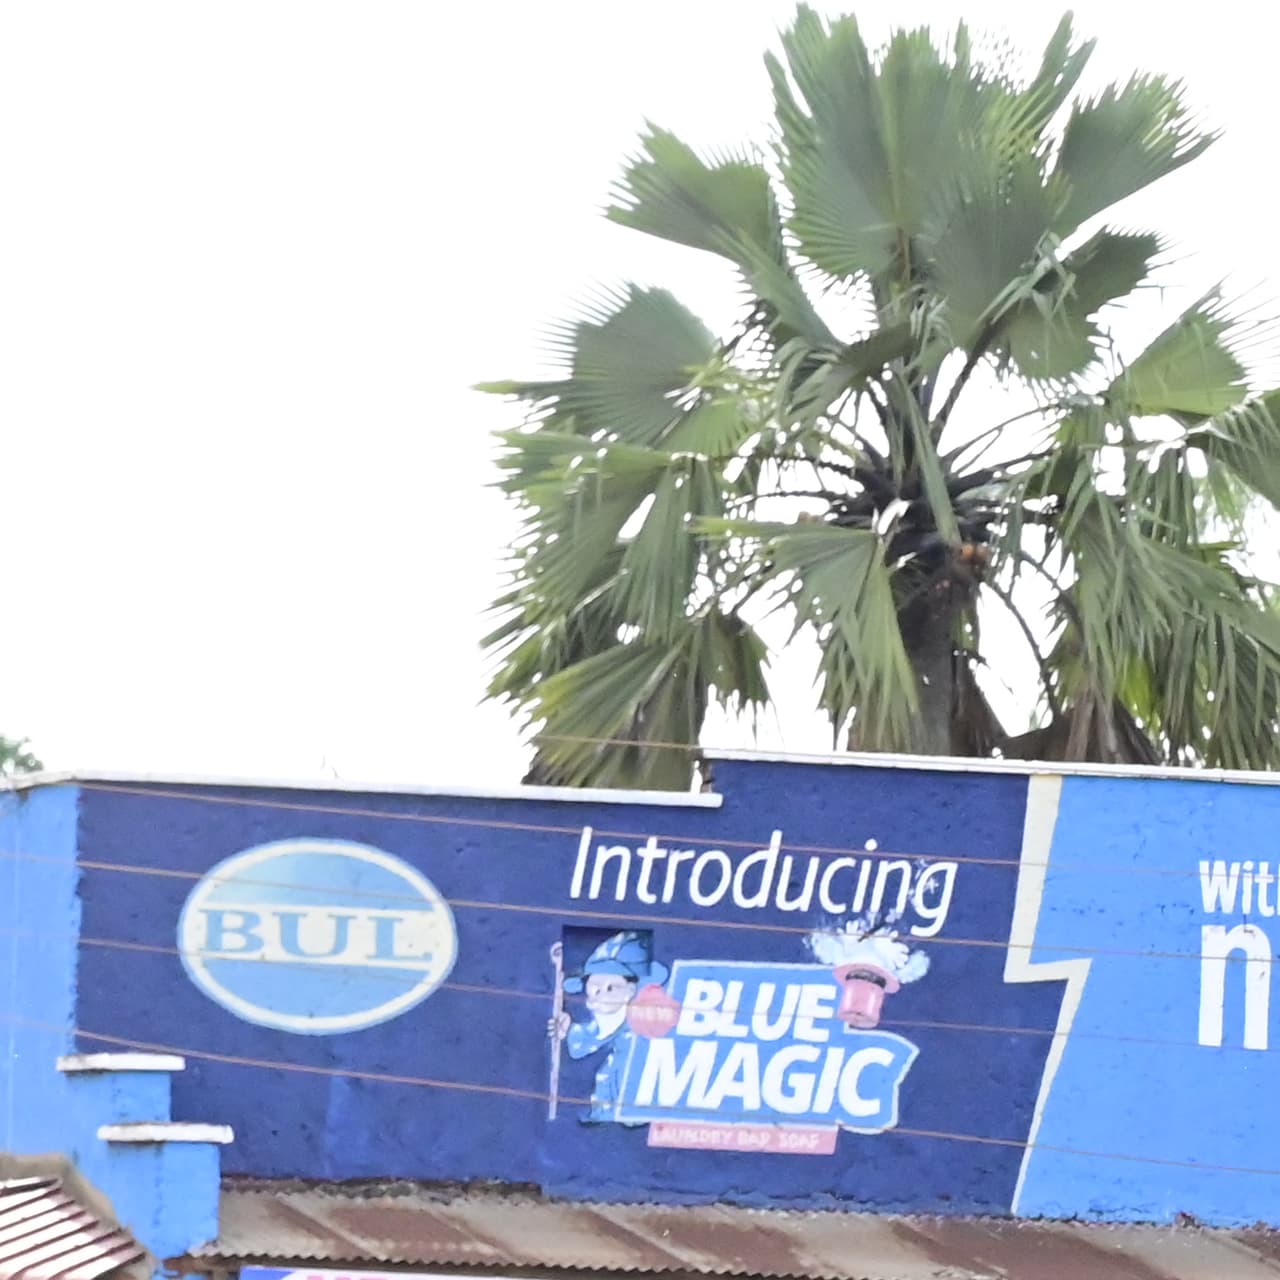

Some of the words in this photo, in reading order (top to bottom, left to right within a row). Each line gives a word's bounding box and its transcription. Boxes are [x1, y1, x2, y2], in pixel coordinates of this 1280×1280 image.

[570, 826, 958, 937] Introducing
[1199, 860, 1280, 917] Wit
[198, 908, 434, 961] BUL
[676, 978, 837, 1042] BLUE
[635, 1038, 895, 1117] MAGIC
